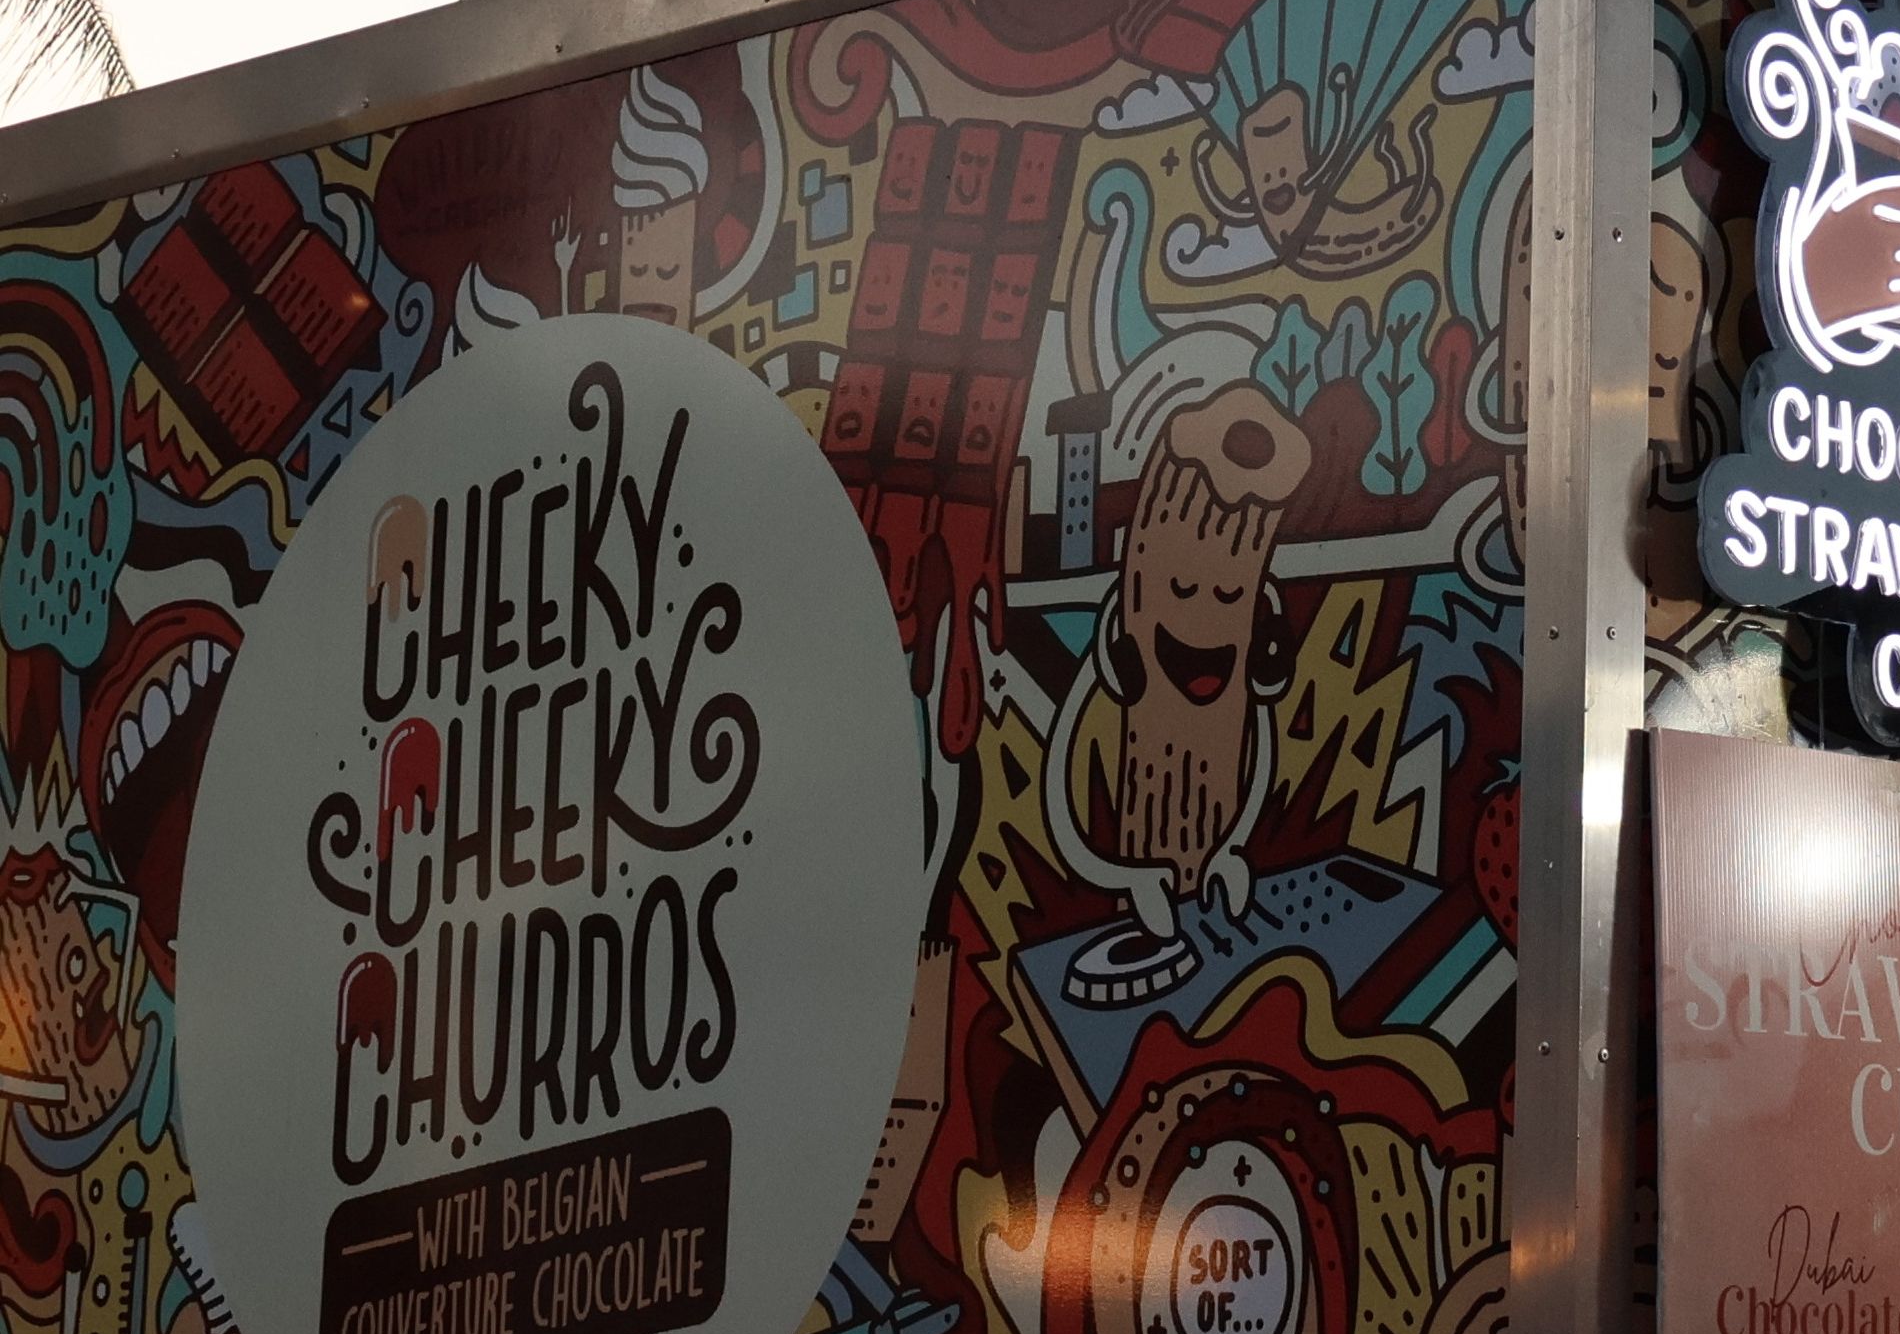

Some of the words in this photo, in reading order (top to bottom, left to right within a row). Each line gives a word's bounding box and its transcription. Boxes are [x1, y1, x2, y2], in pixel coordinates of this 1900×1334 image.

[363, 360, 690, 723] CHEEKY
[307, 582, 760, 948] CHEEKY
[331, 867, 738, 1186] CHURROS
[417, 1187, 486, 1272] WITH
[502, 1155, 632, 1250] BELGIAN
[1188, 1238, 1274, 1286] SORT
[1767, 1204, 1876, 1327] Dubai
[531, 1226, 706, 1327] CHOCOLATE
[1196, 1292, 1265, 1334] OF...
